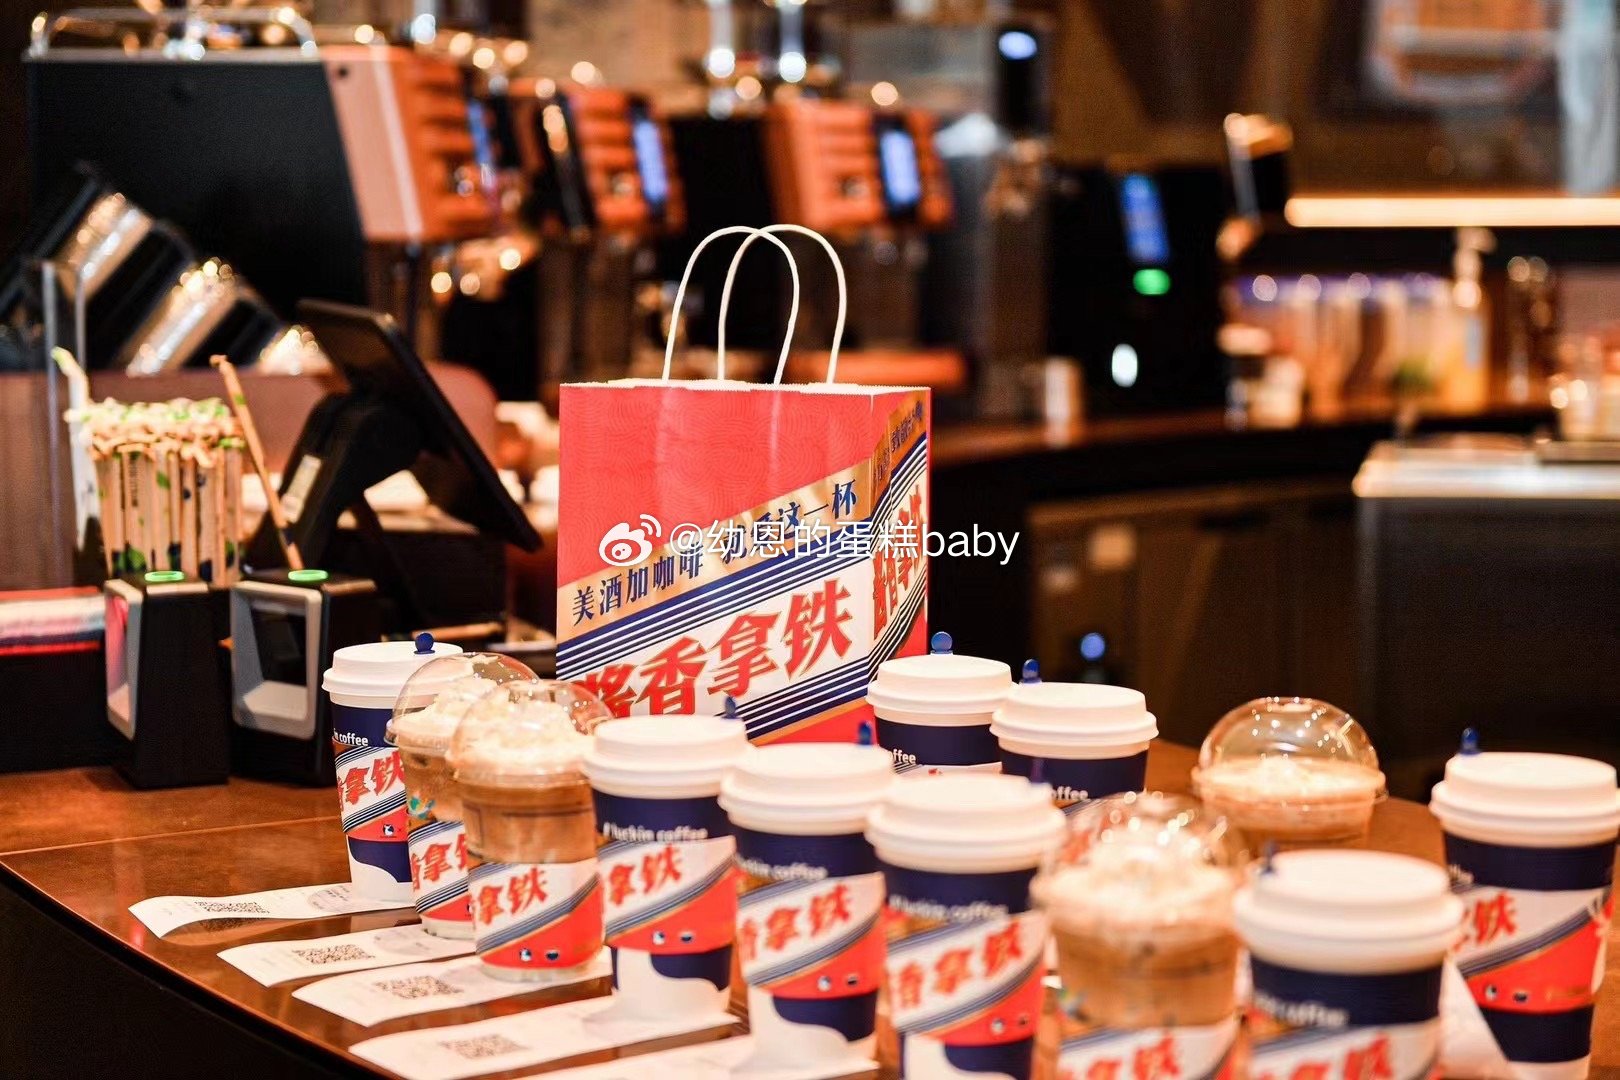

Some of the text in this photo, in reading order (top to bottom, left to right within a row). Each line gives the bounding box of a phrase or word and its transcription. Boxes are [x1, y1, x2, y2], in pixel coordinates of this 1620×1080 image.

[339, 732, 369, 747] coffee
[337, 750, 405, 812] 拿铁
[656, 825, 708, 842] coffee
